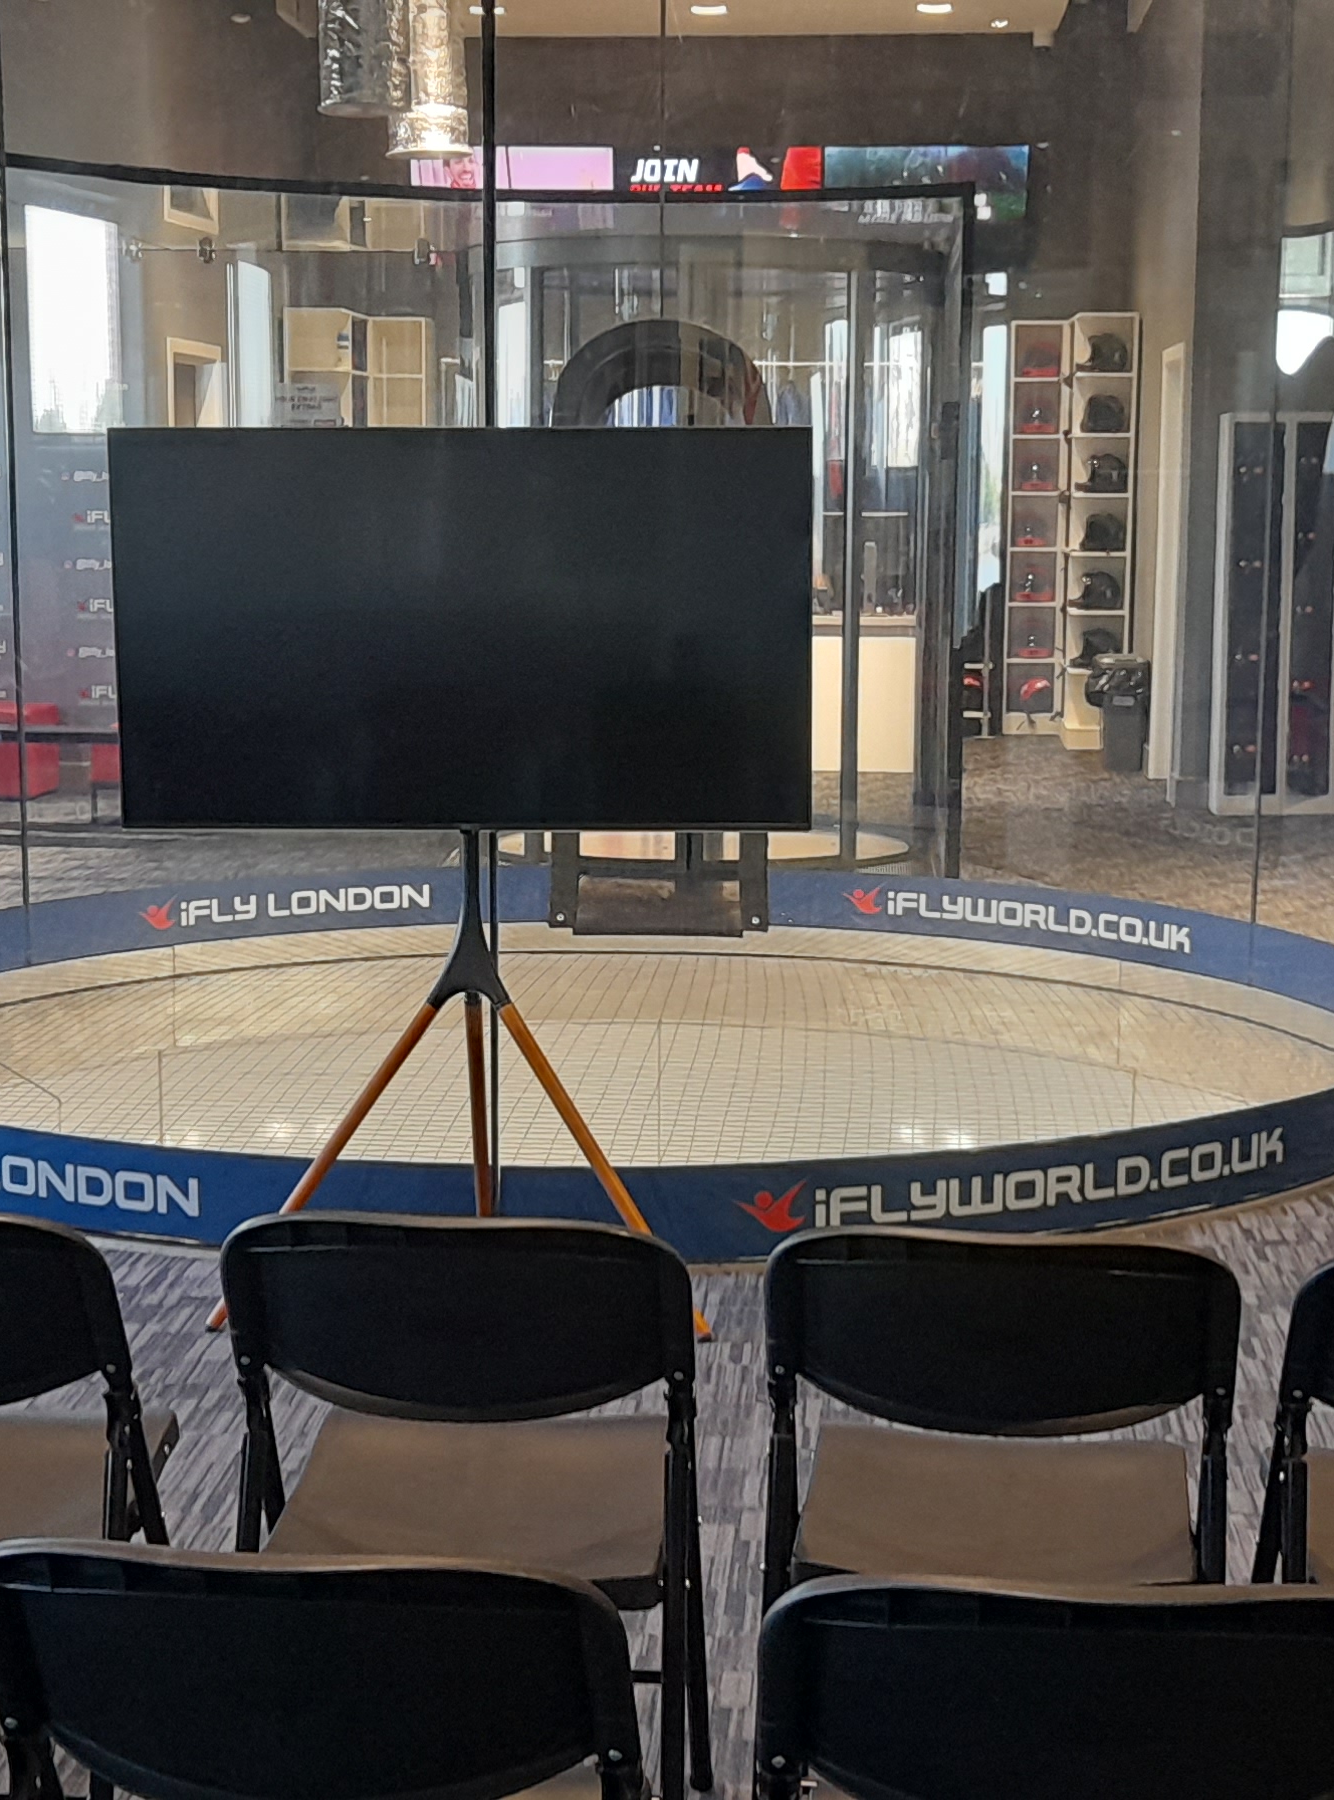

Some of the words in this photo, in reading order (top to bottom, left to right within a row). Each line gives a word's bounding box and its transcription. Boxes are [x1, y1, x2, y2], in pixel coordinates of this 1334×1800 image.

[630, 158, 699, 183] JOIN
[179, 894, 257, 928] iFLY
[267, 883, 431, 918] LONDON
[885, 890, 1192, 954] iFLYWORLD.CO.UK
[814, 1126, 1284, 1228] iFLYWORLD.CO.UK
